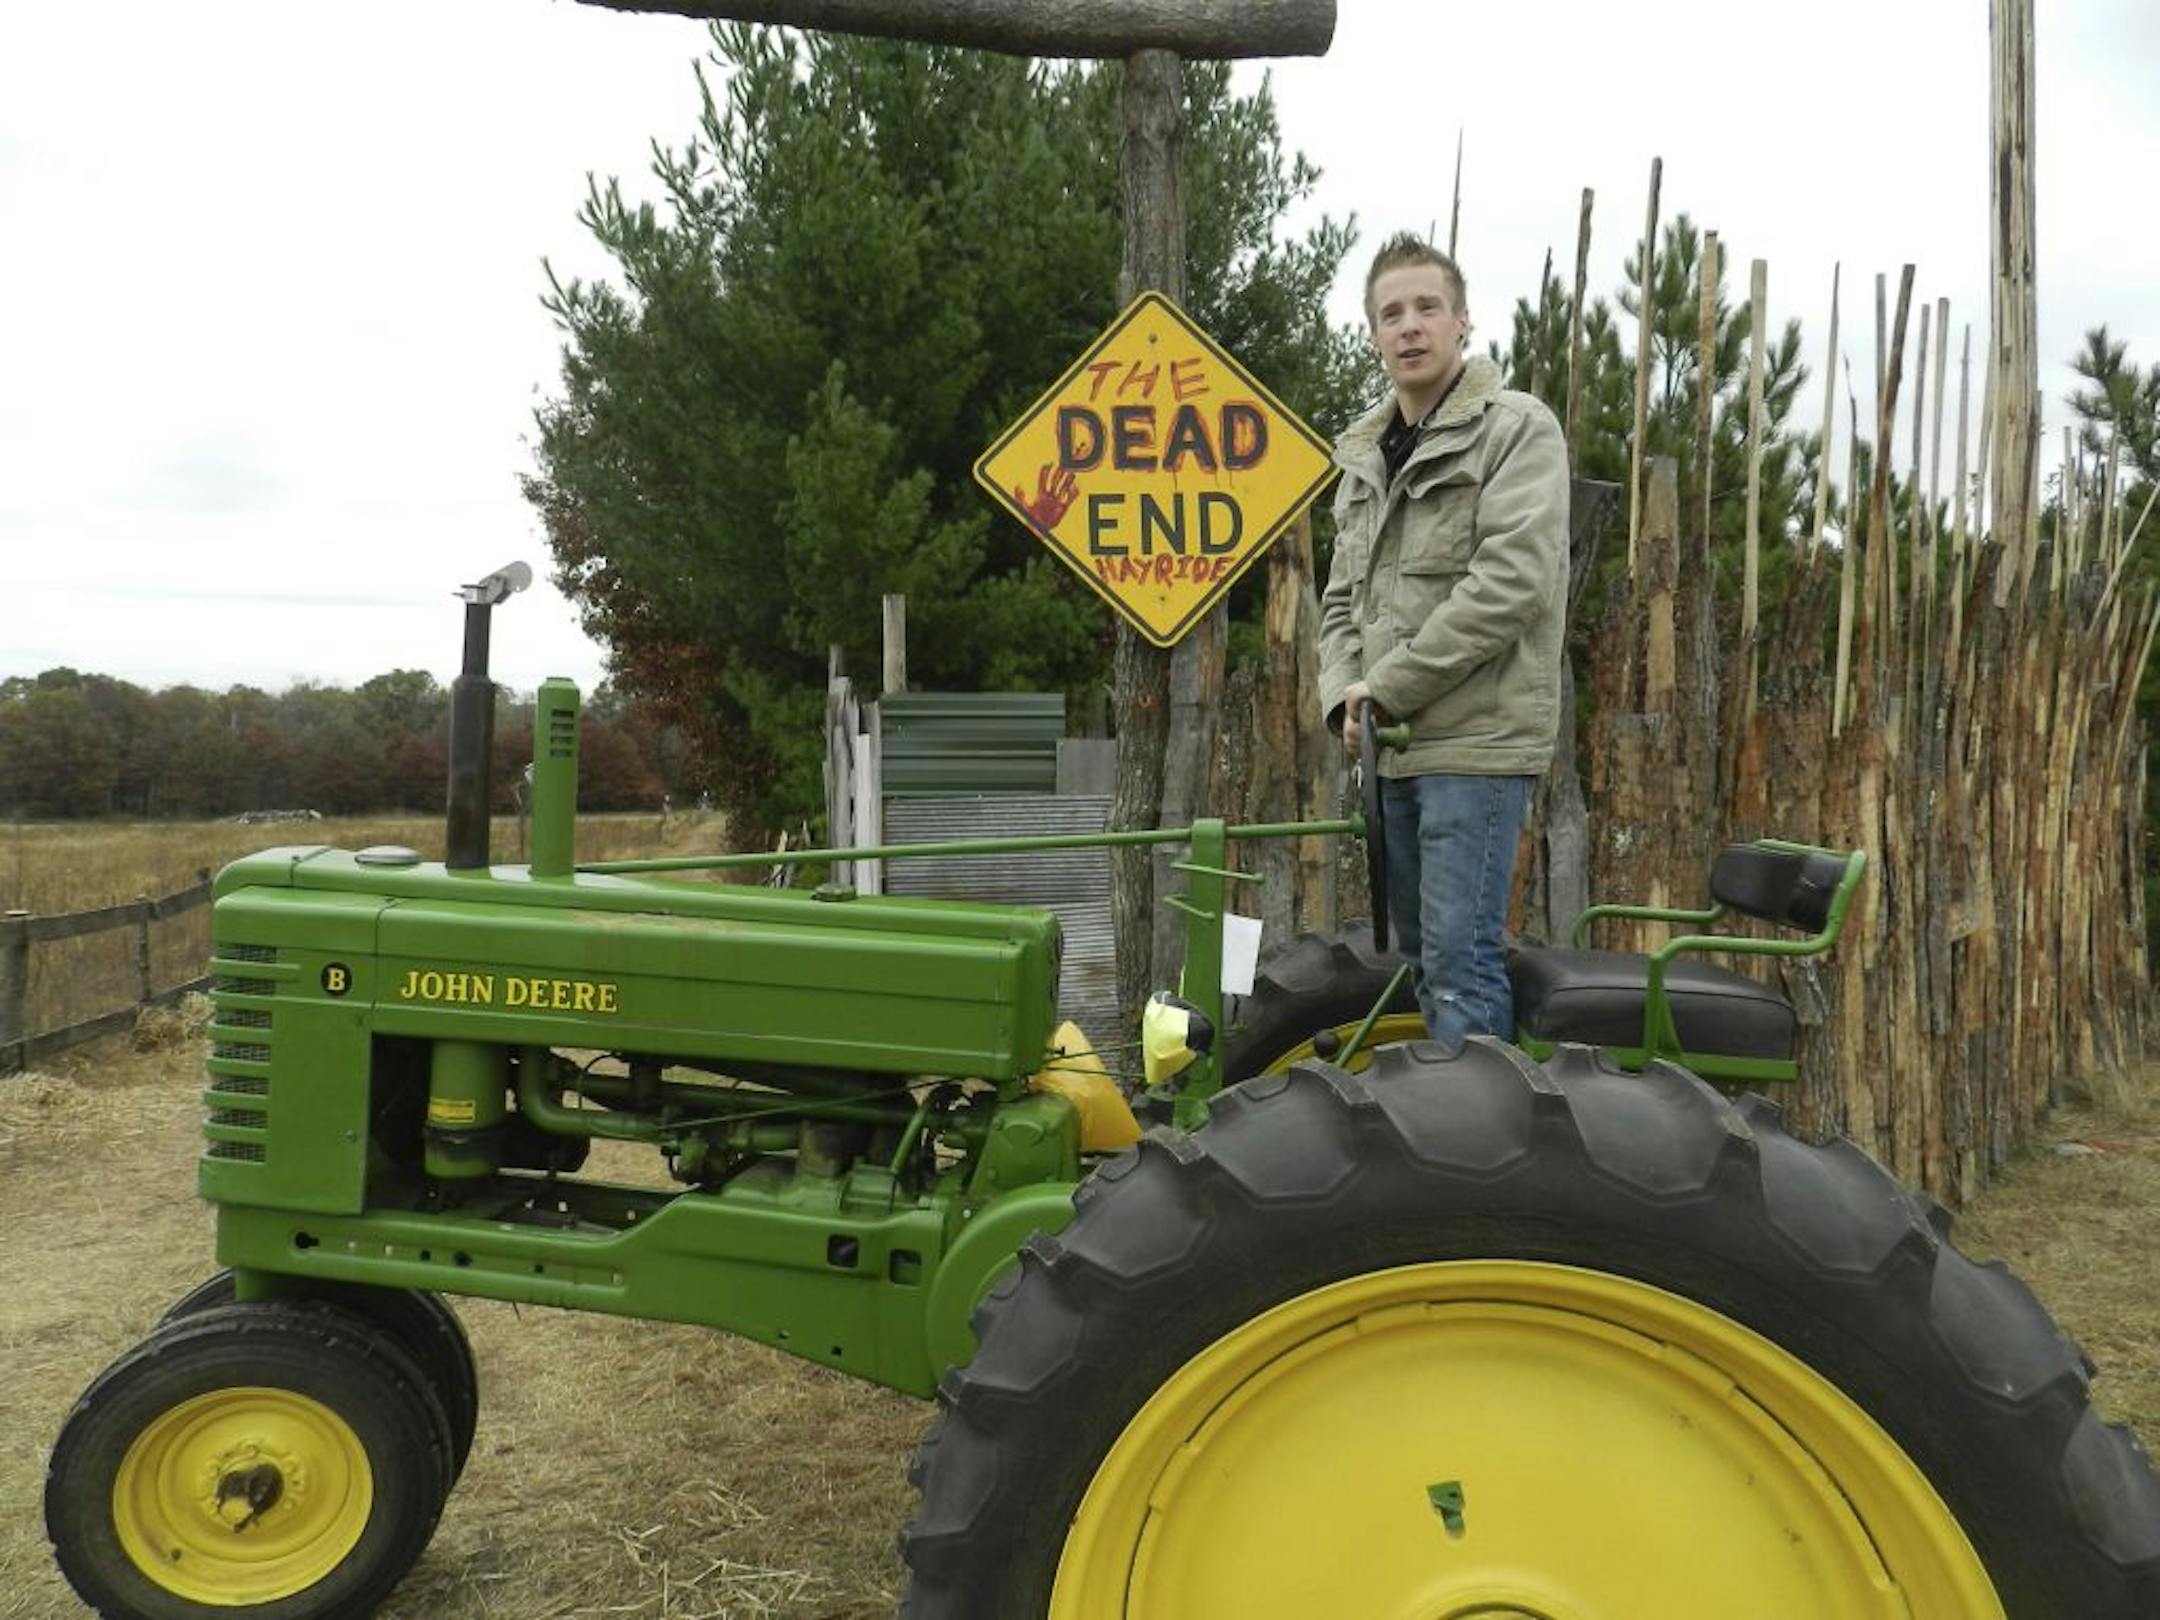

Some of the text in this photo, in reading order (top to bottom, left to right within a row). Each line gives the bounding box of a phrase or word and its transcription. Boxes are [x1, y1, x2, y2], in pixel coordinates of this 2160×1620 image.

[1089, 358, 1209, 400] THE
[1056, 401, 1269, 473] DEAD
[1088, 492, 1243, 556] END
[1095, 553, 1234, 588] HAYRIDE
[327, 967, 345, 991] B
[401, 970, 618, 1013] JOHN DEERE
